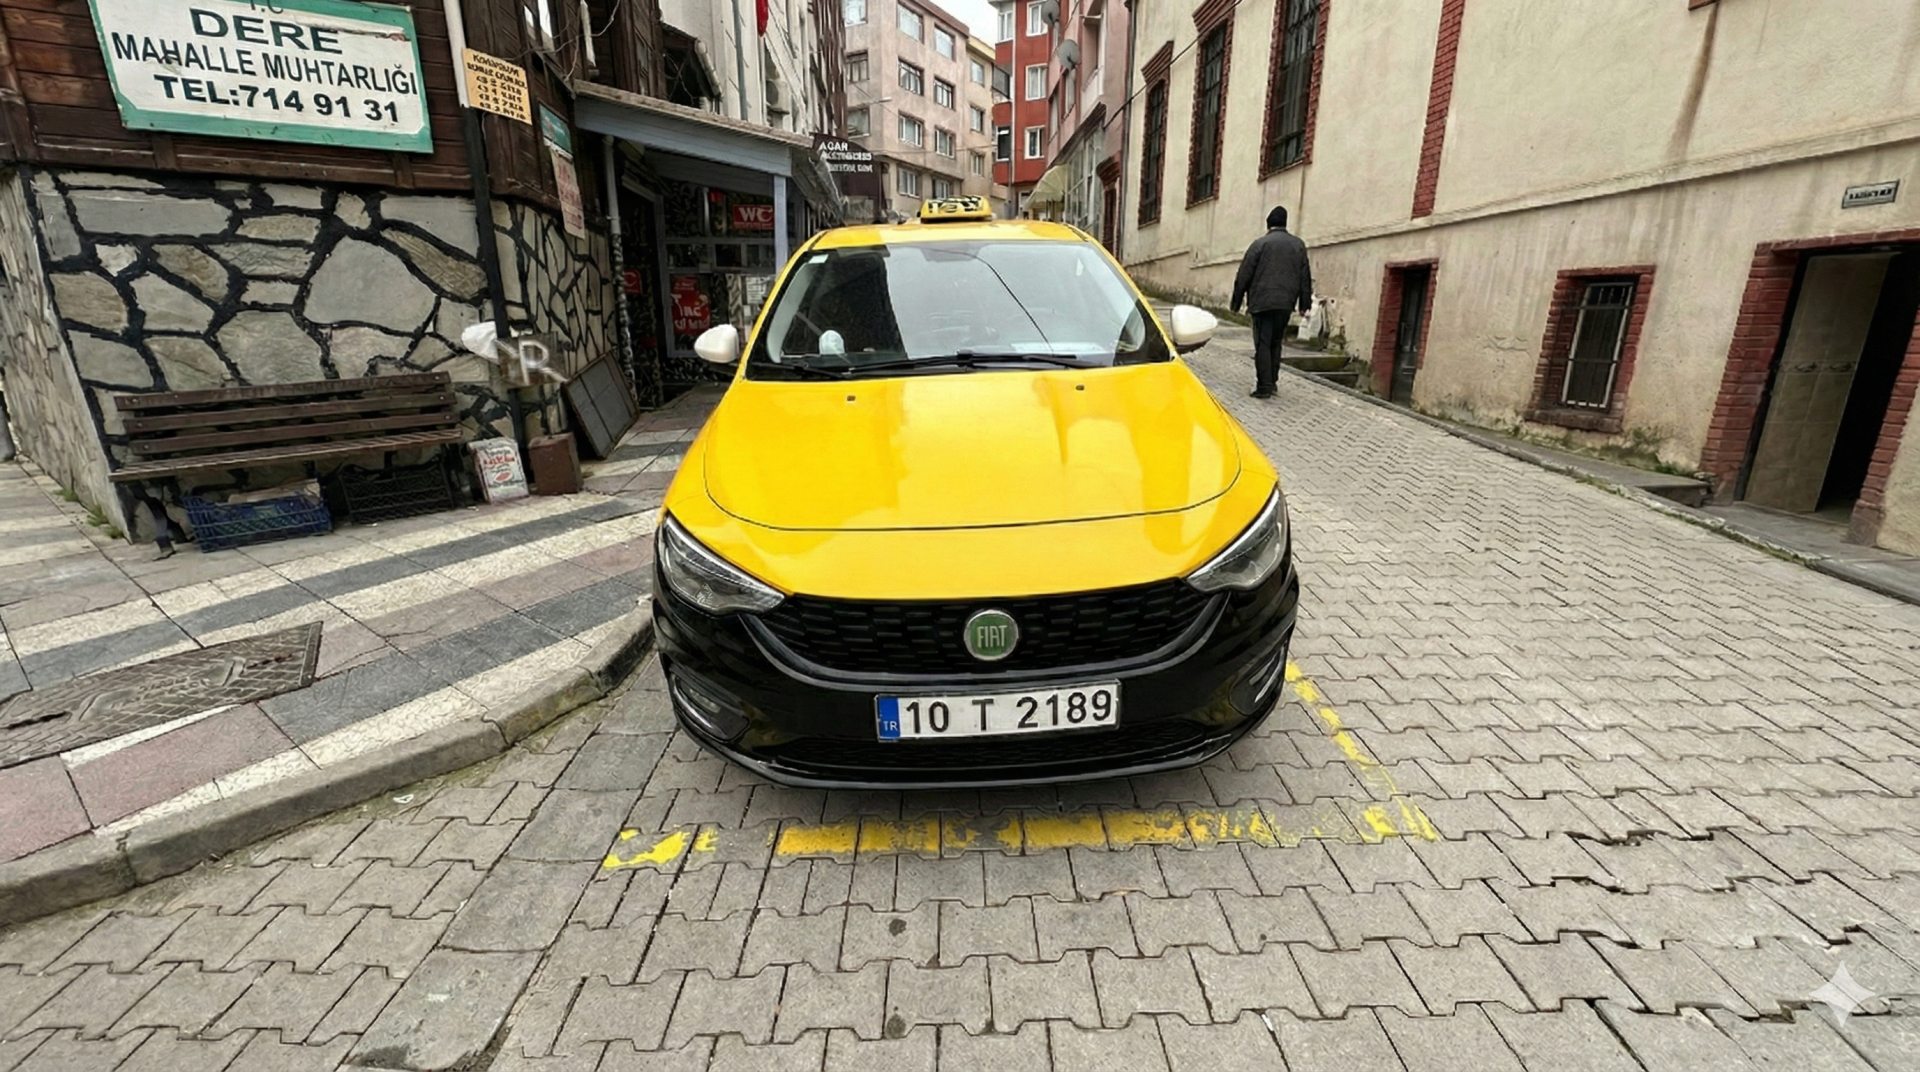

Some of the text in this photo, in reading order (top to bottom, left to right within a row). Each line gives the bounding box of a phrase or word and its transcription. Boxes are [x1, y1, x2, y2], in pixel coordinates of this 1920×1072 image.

[189, 8, 343, 55] DERE
[111, 32, 257, 77] MAHALLE
[262, 52, 418, 95] MUHTARLIĞI
[313, 93, 351, 118] 91
[363, 99, 398, 123] 31
[738, 206, 773, 222] WC
[977, 624, 1008, 649] FIAT
[882, 720, 898, 732] TR
[905, 689, 1112, 734] 10 T 2189
